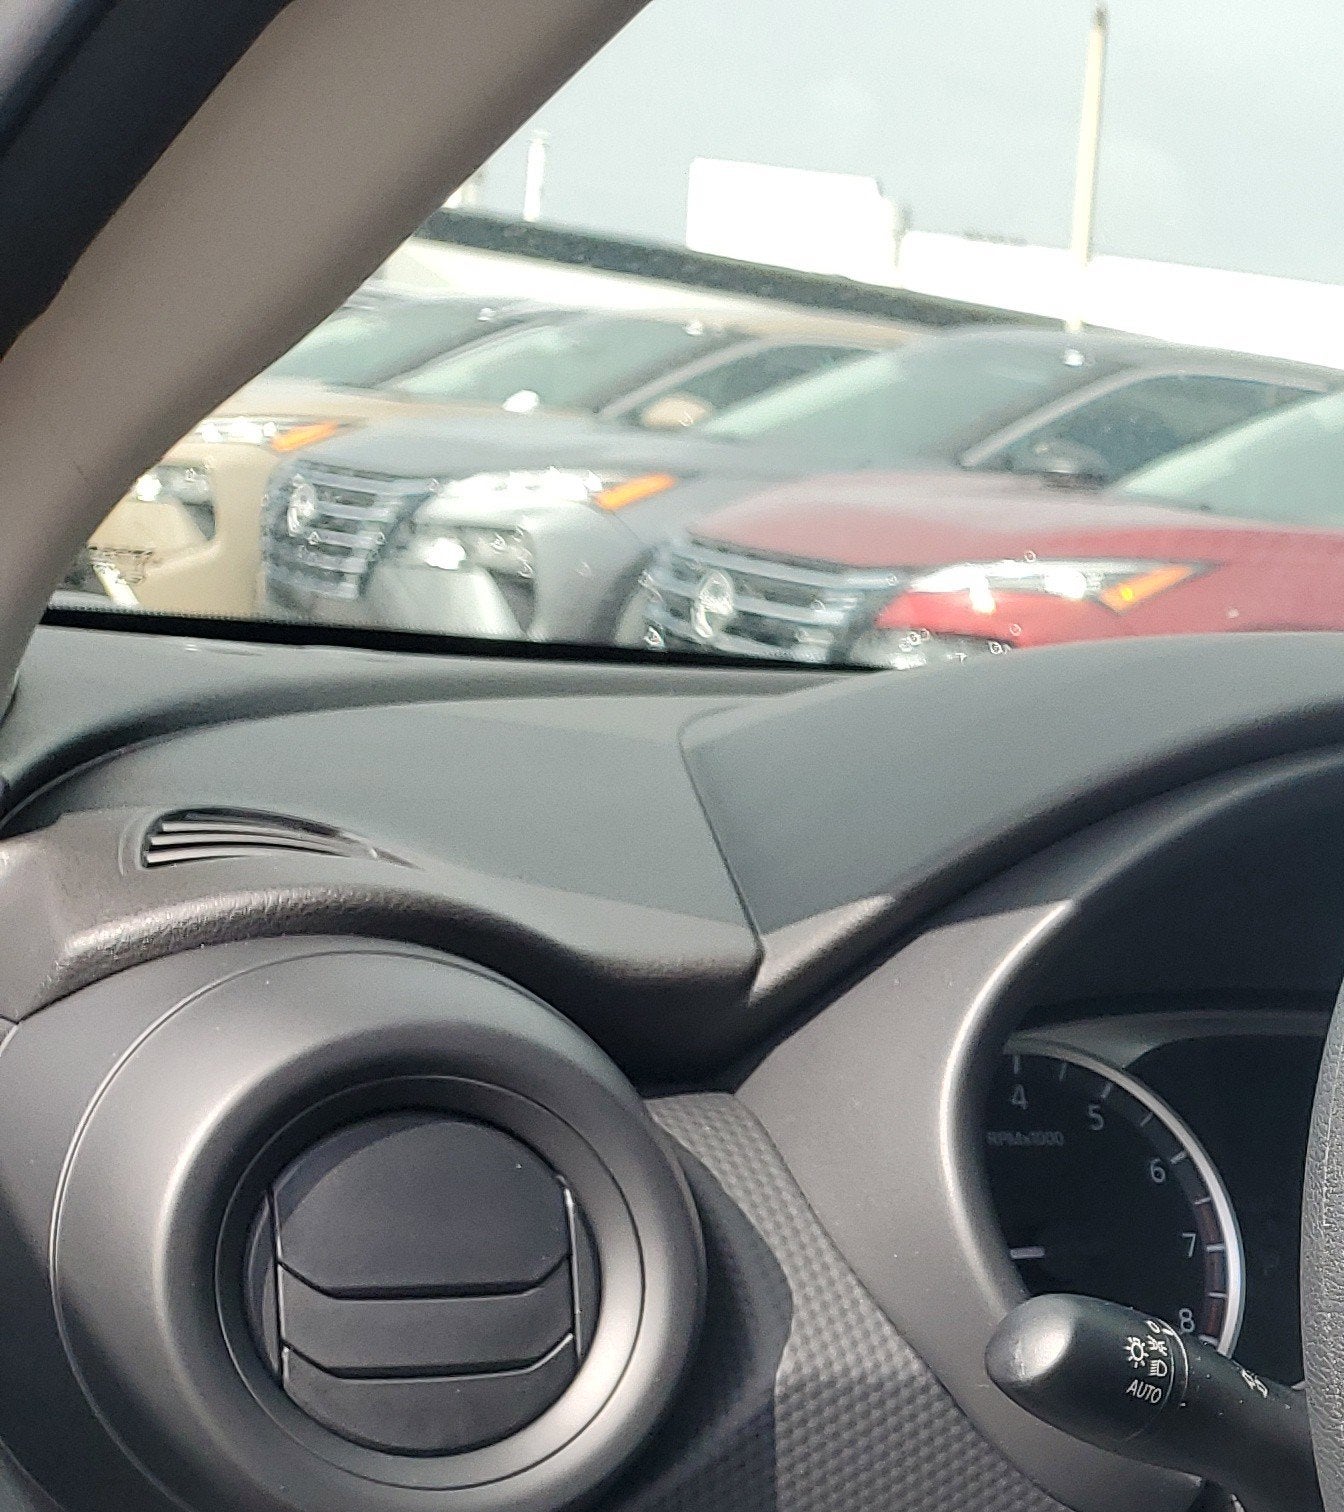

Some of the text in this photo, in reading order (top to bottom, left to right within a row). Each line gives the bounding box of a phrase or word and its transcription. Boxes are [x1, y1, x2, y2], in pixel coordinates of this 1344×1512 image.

[1087, 1103, 1104, 1131] 5
[1149, 1157, 1166, 1183] 6
[1182, 1233, 1196, 1258] 7
[1178, 1307, 1196, 1334] 8
[1125, 1379, 1163, 1404] AUTO
